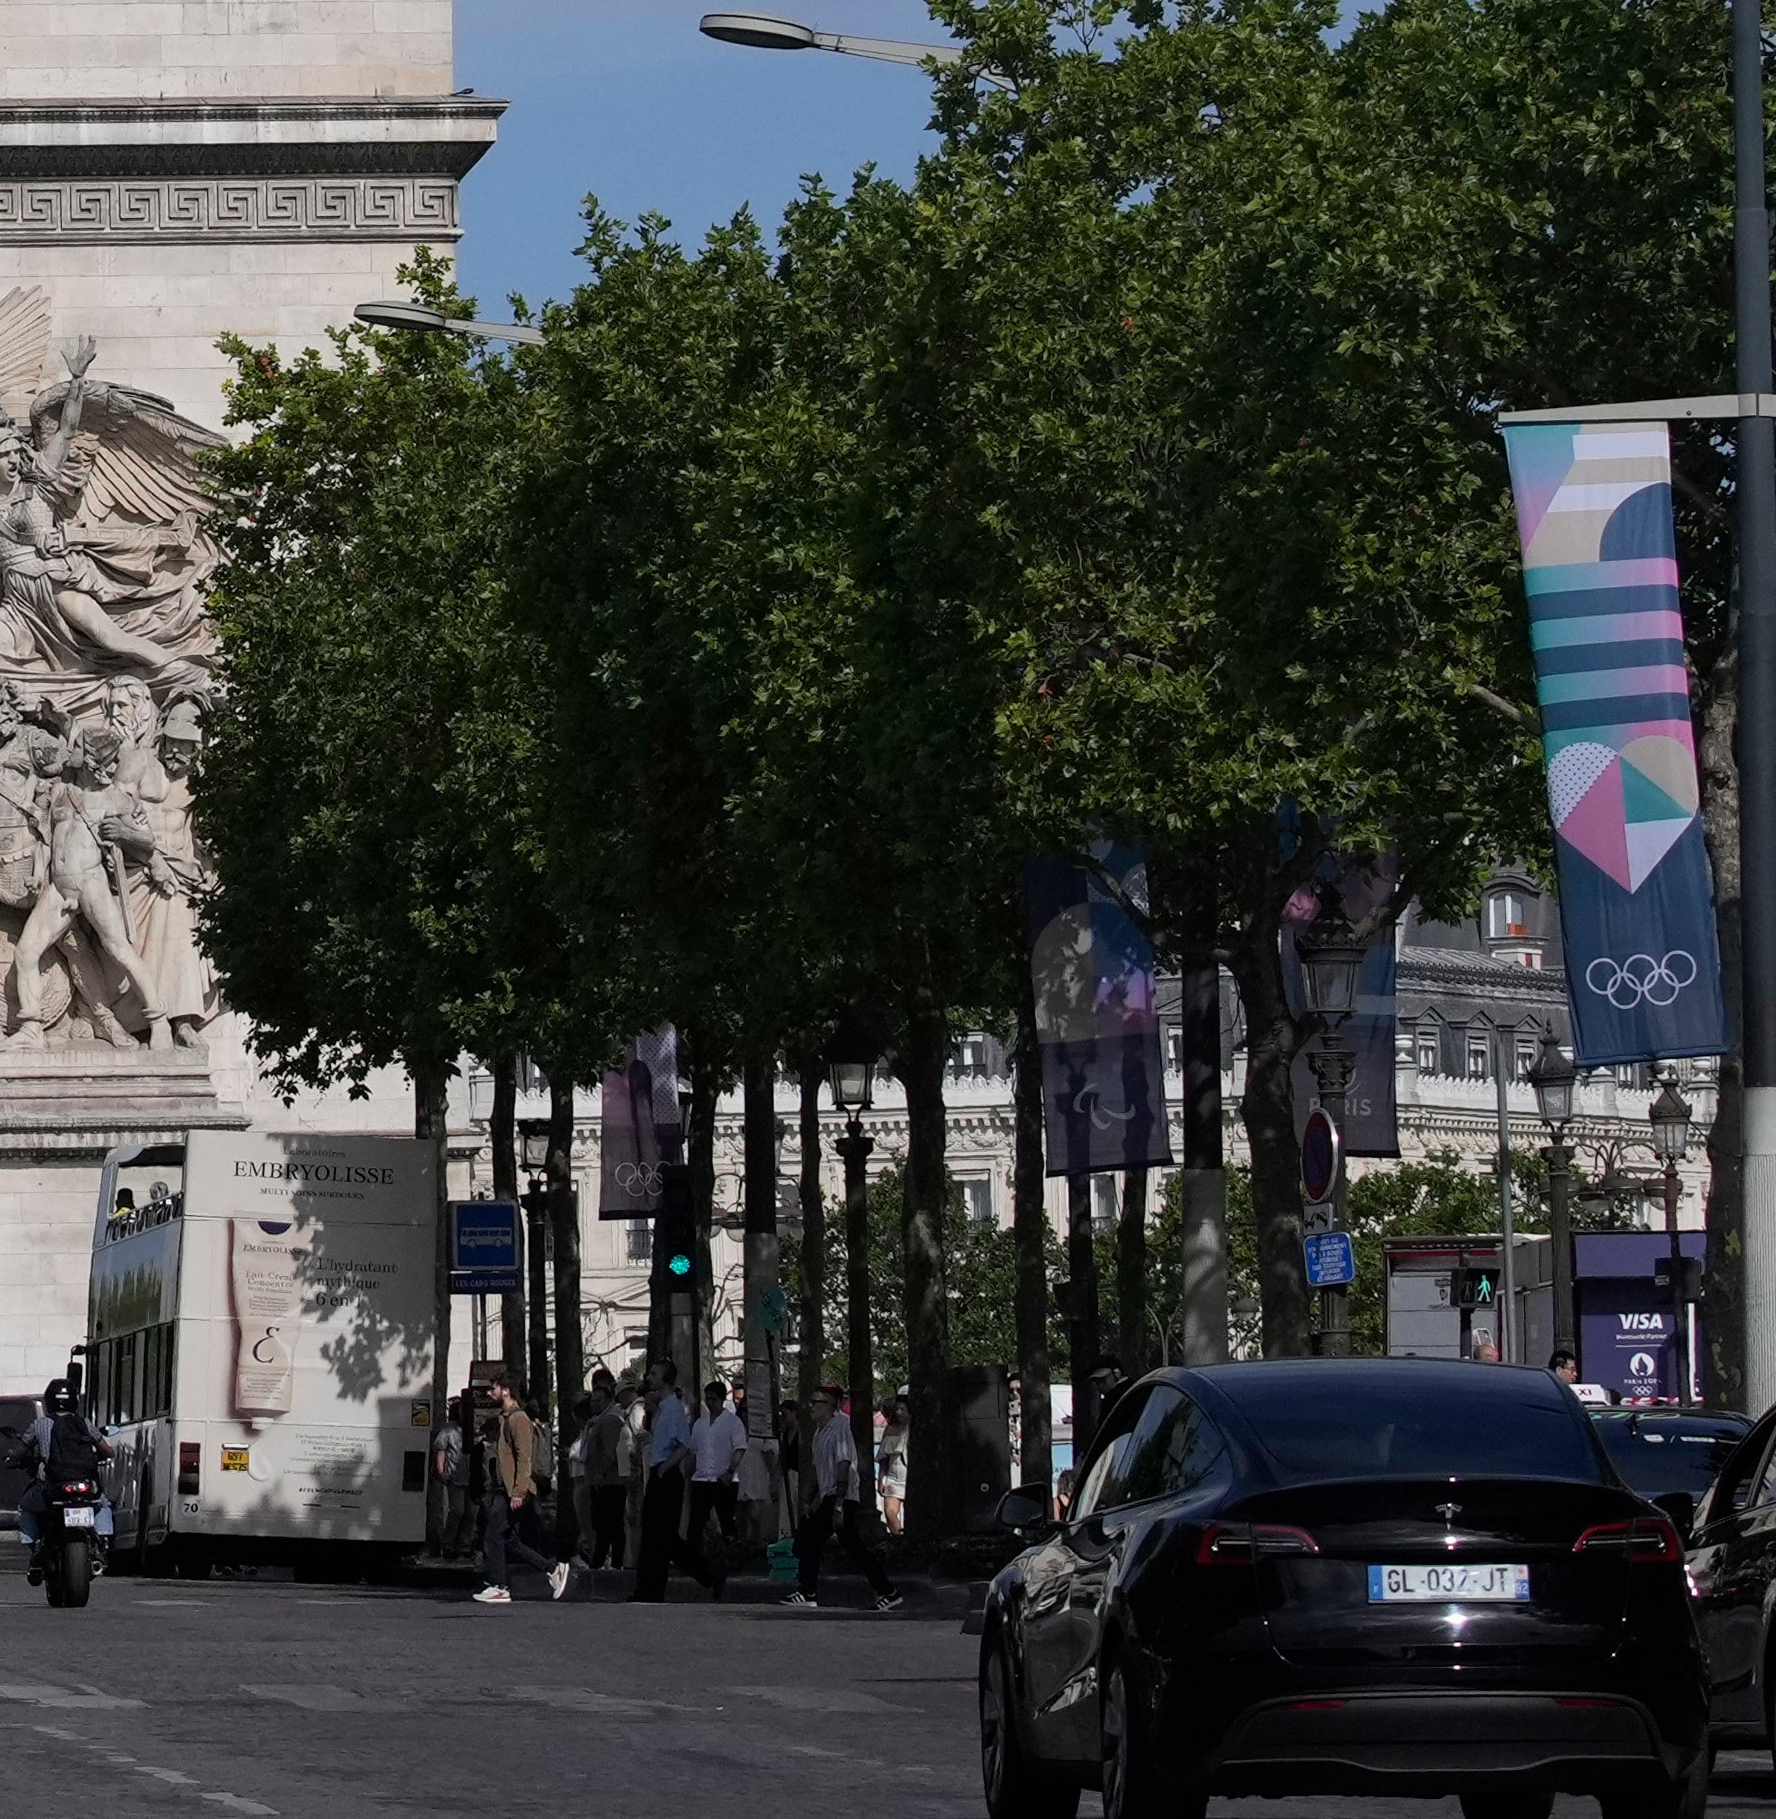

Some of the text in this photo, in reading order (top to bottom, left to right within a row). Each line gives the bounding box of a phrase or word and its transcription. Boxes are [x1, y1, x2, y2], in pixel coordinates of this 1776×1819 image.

[233, 1160, 394, 1185] EMBRYOLISSE
[316, 1291, 326, 1306] 6
[1617, 1313, 1663, 1330] VISA
[183, 1503, 198, 1513] 70
